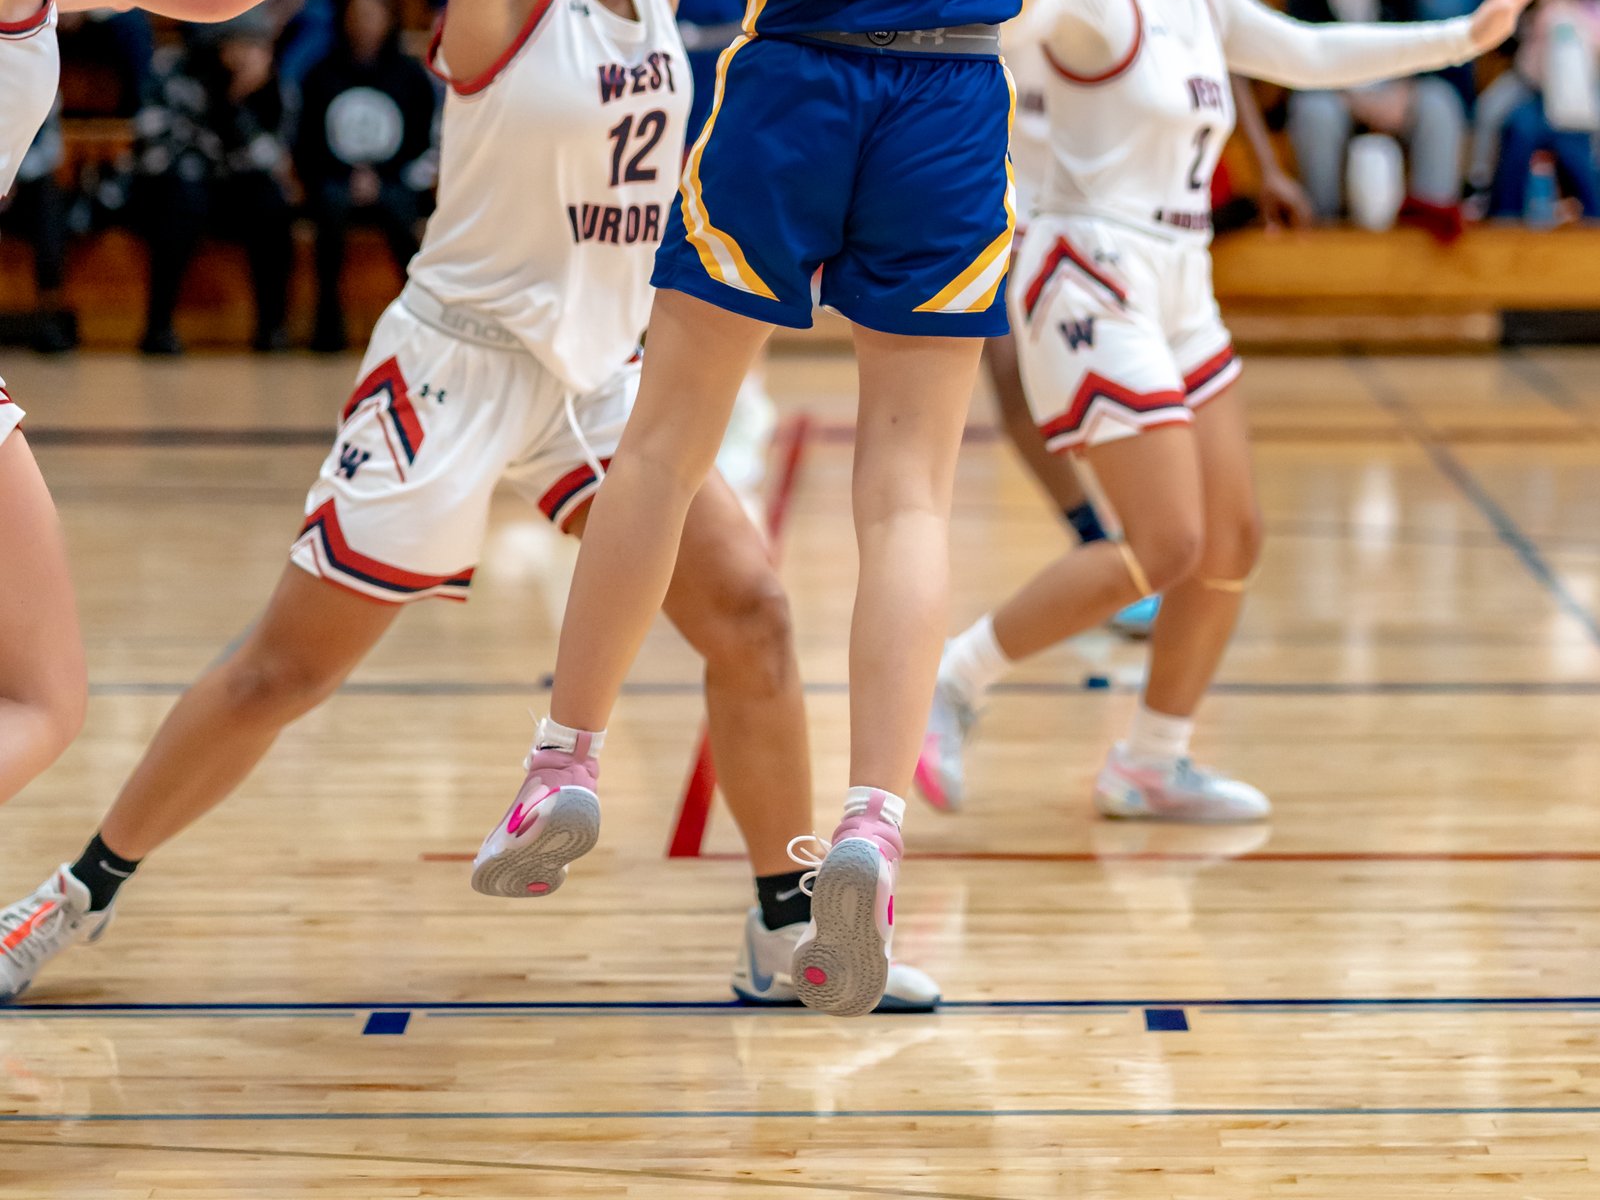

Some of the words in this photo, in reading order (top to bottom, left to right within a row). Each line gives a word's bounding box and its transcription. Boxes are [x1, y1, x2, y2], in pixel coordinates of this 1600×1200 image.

[597, 52, 676, 104] WEST
[607, 109, 668, 188] 12
[1187, 125, 1213, 191] 2
[566, 202, 662, 245] UROR
[1058, 314, 1097, 353] W
